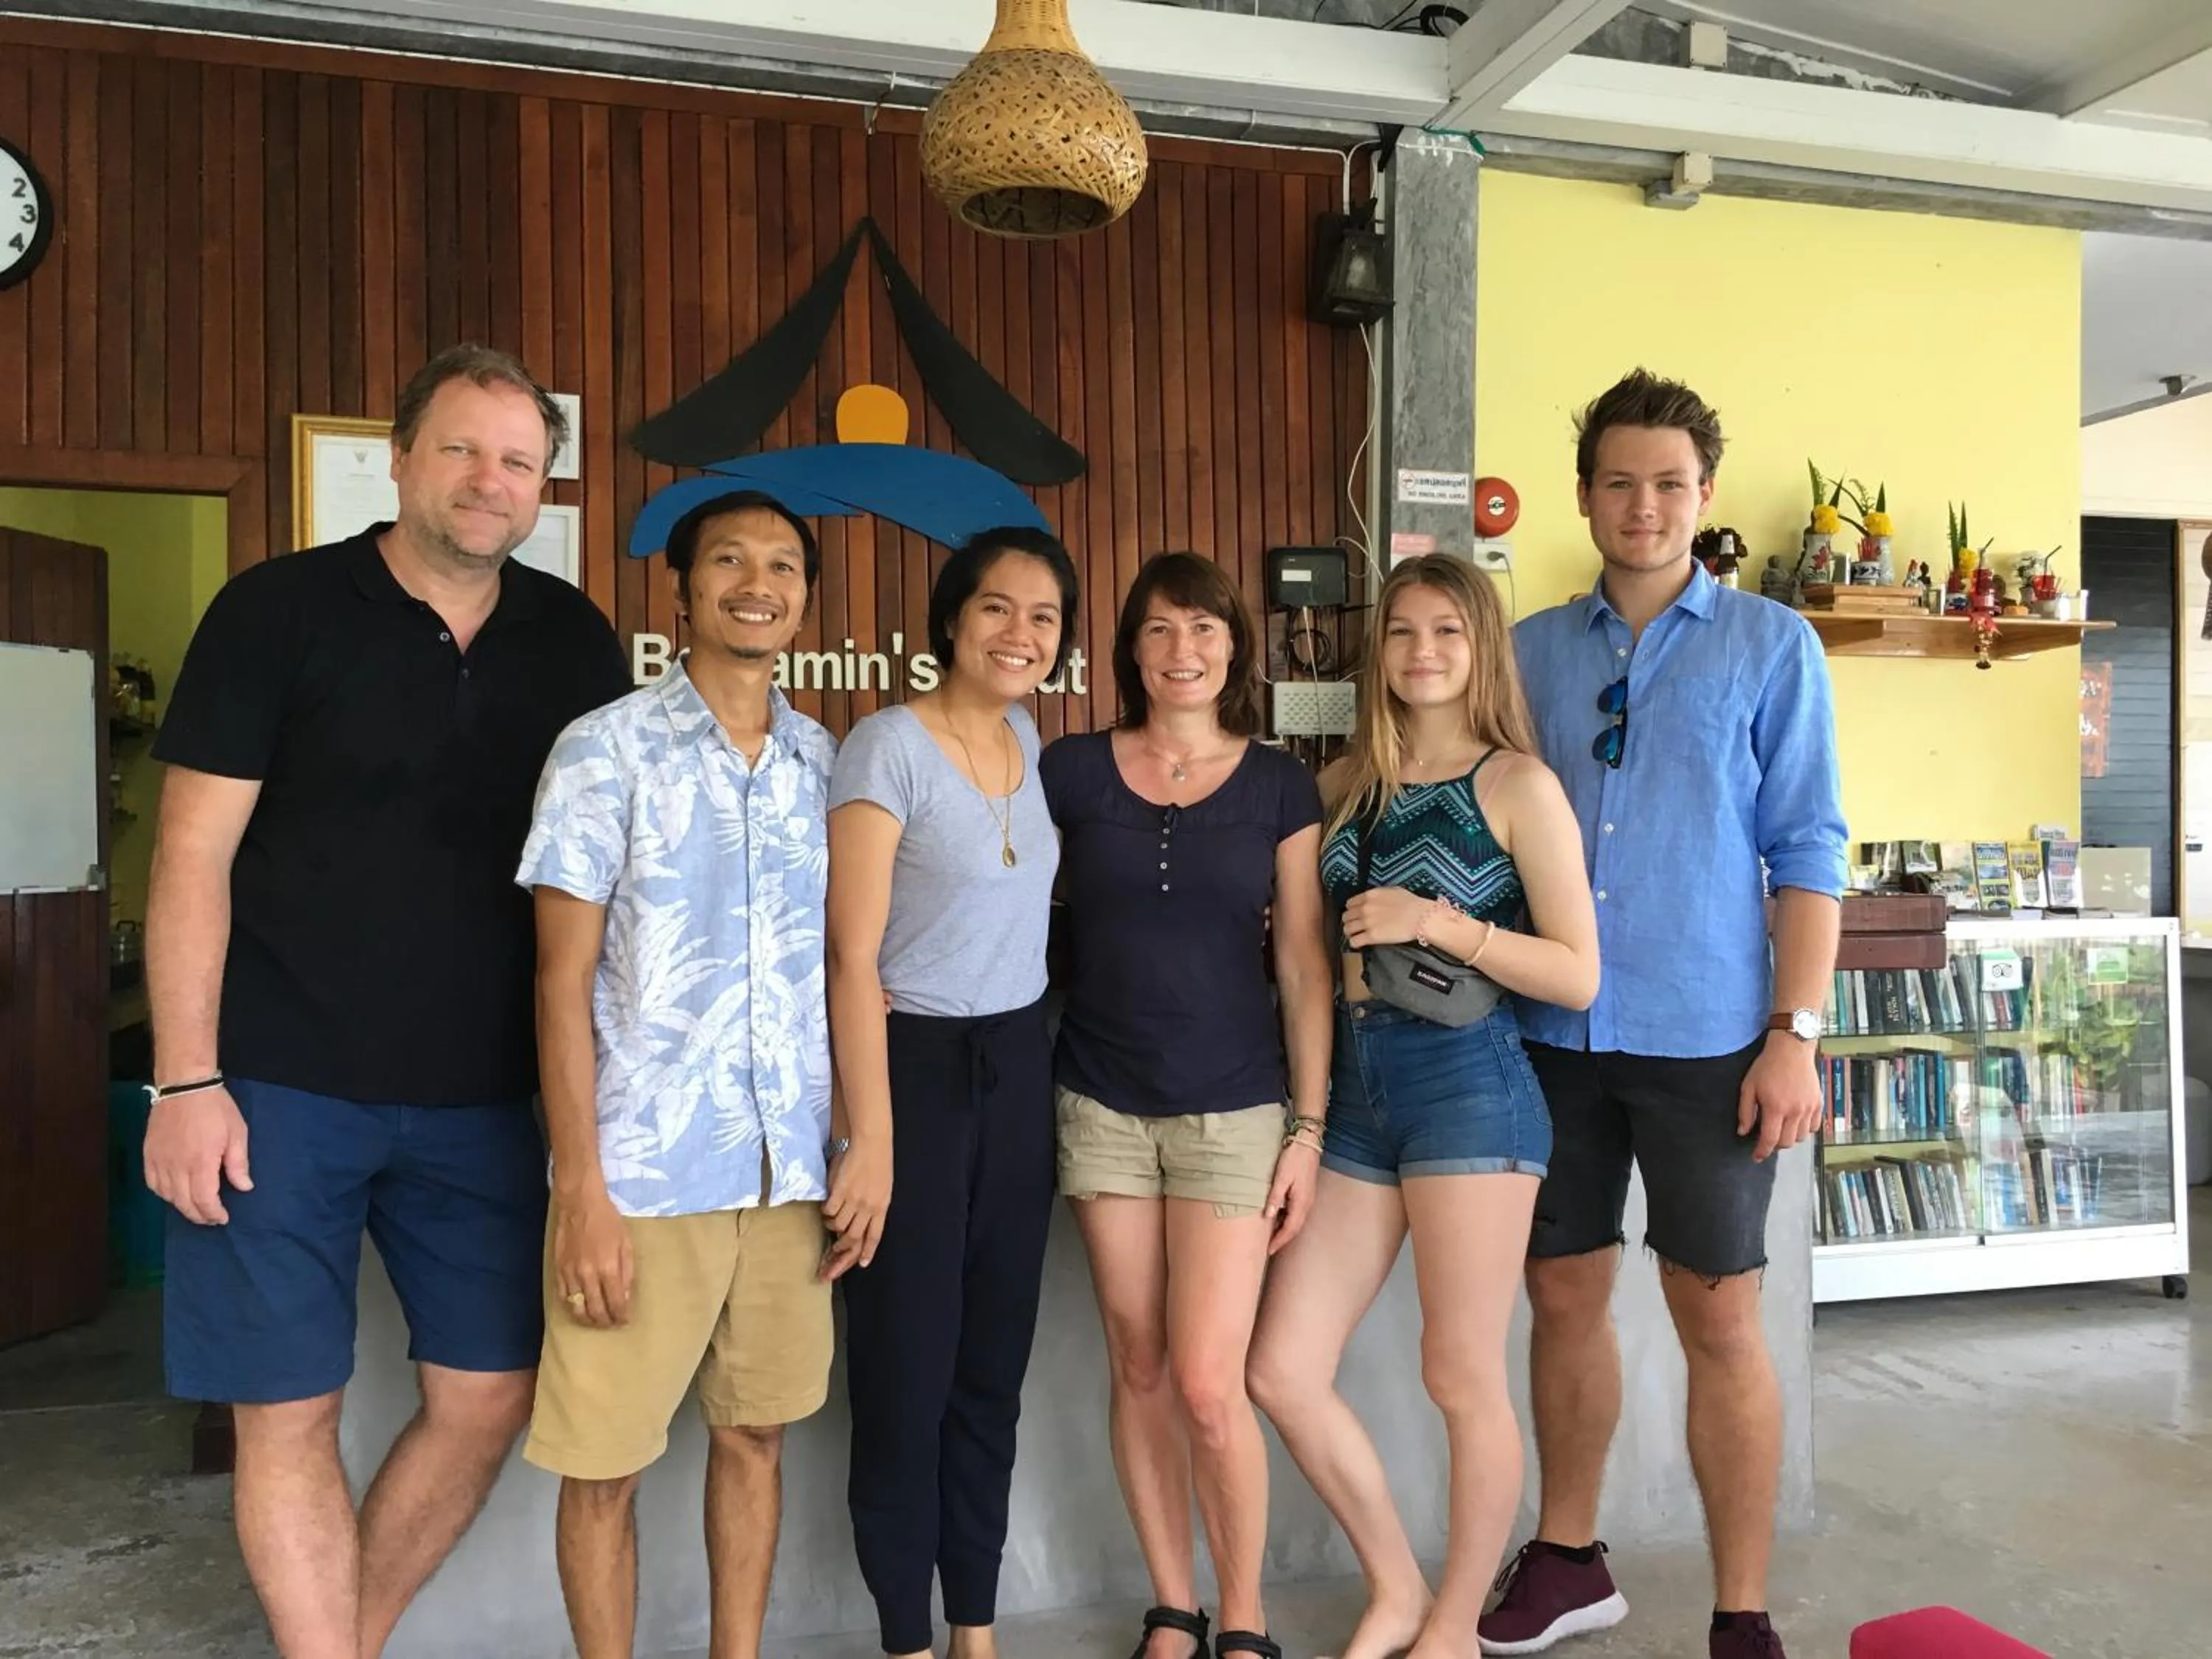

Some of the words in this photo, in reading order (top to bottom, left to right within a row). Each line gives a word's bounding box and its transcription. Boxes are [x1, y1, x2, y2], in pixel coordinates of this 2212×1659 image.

[12, 178, 27, 198] 2
[20, 204, 36, 224] 3
[9, 232, 24, 252] 4
[633, 632, 939, 692] Bamin's
